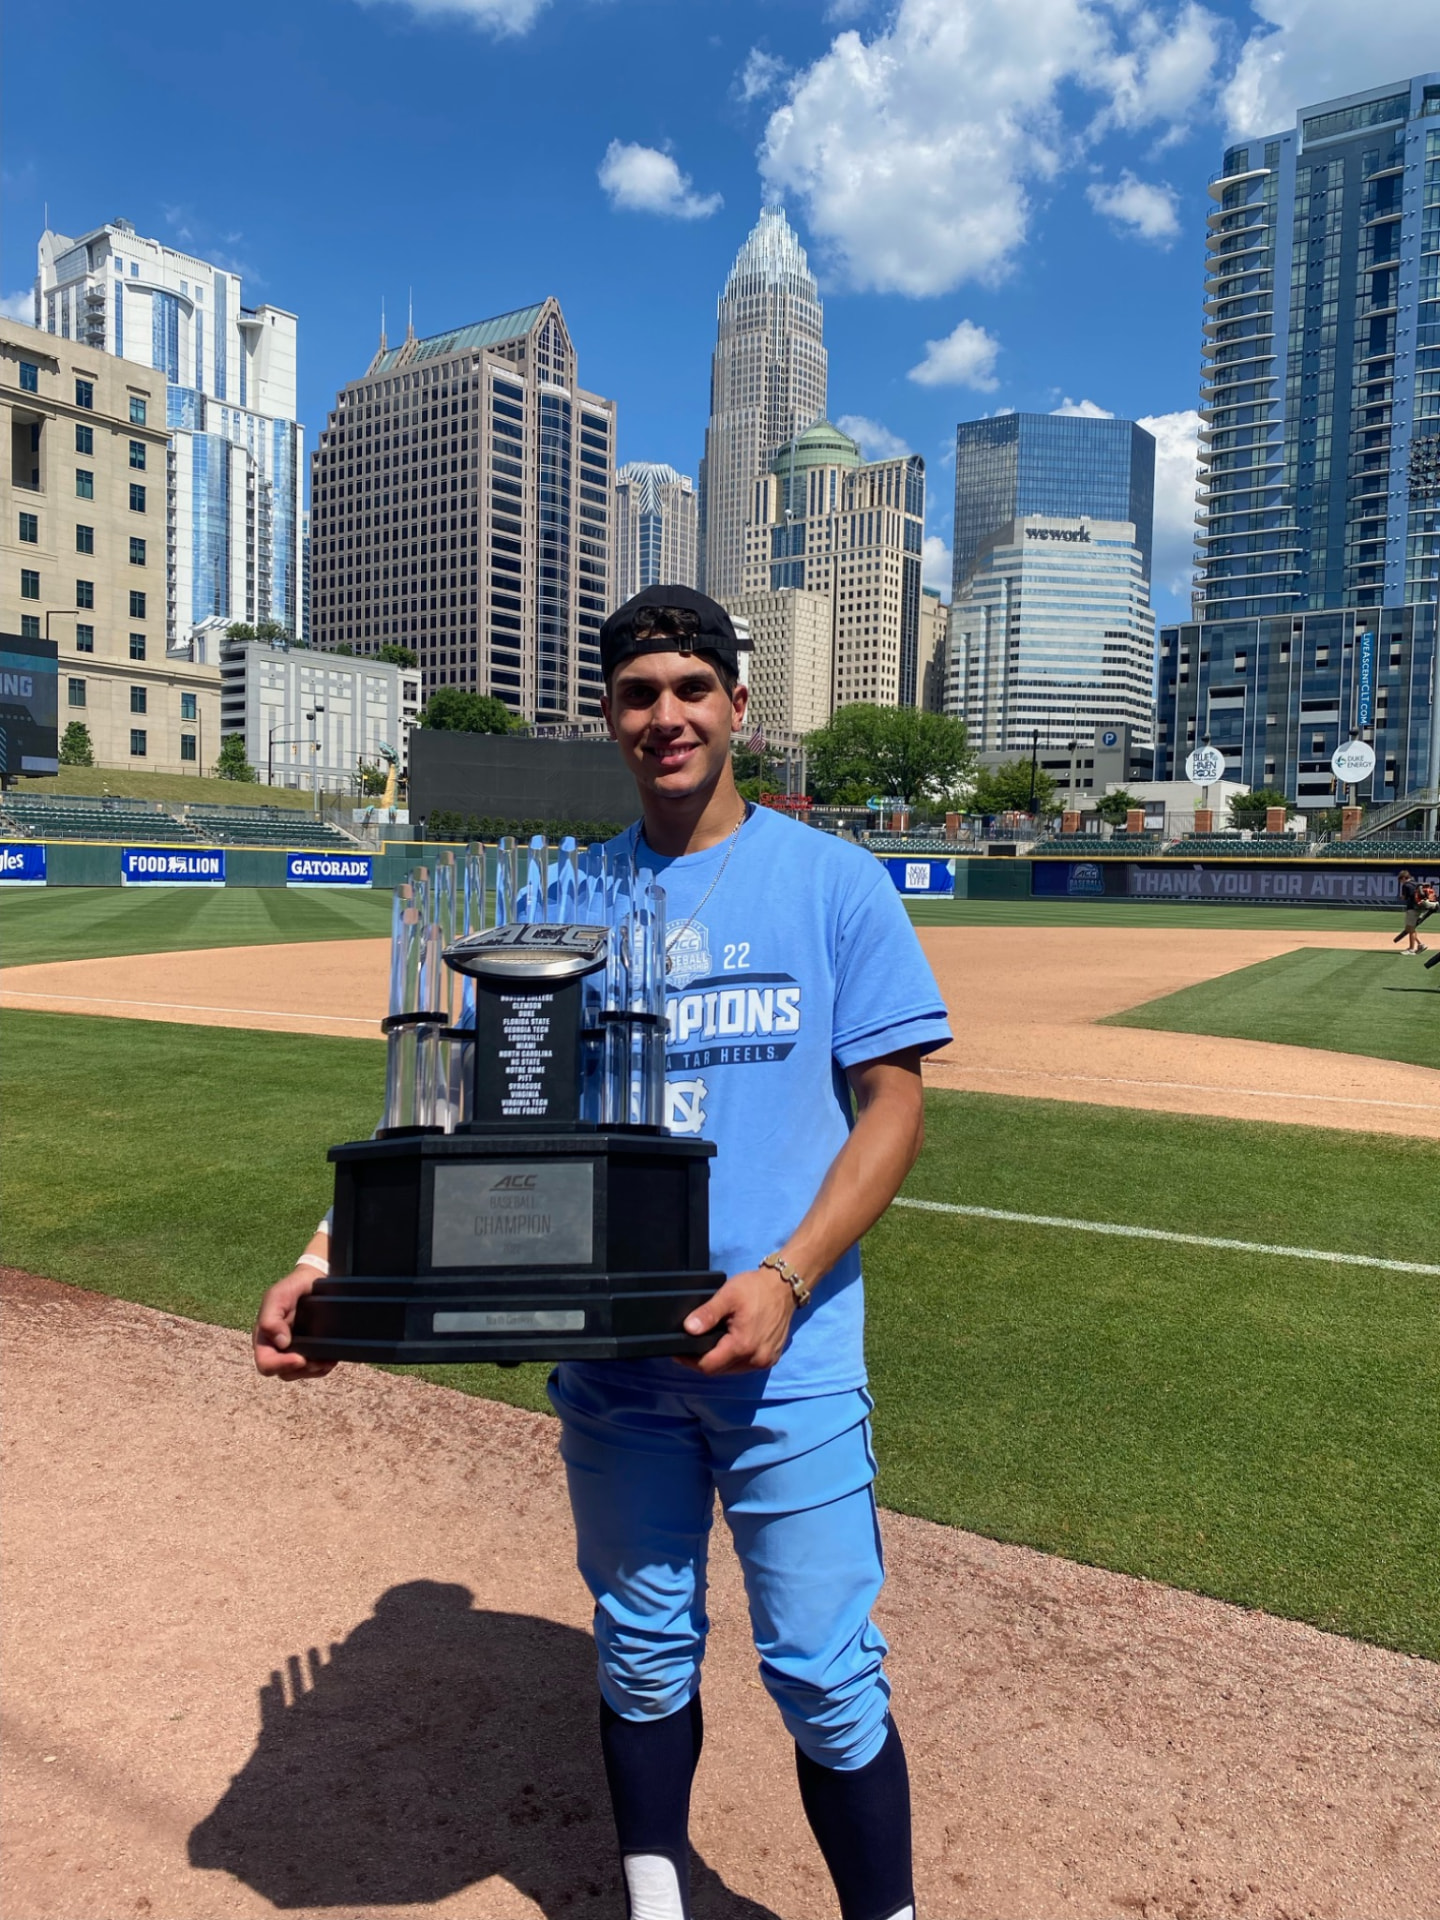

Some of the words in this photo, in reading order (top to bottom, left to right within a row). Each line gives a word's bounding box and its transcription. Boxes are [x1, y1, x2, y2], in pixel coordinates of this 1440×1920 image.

[1025, 525, 1091, 543] wework
[1360, 633, 1372, 724] LIVEASCENTCLT.COM
[1105, 733, 1115, 745] P
[1193, 753, 1211, 762] BLUE
[1193, 761, 1217, 769] HAVEN
[1193, 769, 1217, 777] POOLS
[129, 856, 167, 872] FOOD
[188, 858, 219, 874] LION
[291, 860, 369, 876] GATORADE
[909, 878, 926, 886] LIFE
[1133, 872, 1202, 893] THANK
[1211, 873, 1249, 893] YOU
[1261, 874, 1300, 894] FOR
[460, 923, 608, 946] ACC
[723, 942, 751, 970] 22
[512, 1002, 542, 1010] CLEMSON
[502, 1018, 530, 1026] FLORIDA
[530, 1017, 551, 1025] STATE
[532, 1025, 549, 1033] TECH
[508, 1034, 544, 1042] LOUISVILLE
[498, 1050, 520, 1058] NORTH
[521, 1050, 553, 1058] CAROLINA
[683, 1052, 711, 1068] TAR
[720, 1046, 775, 1063] HEELS
[521, 1058, 540, 1066] STATE
[505, 1066, 526, 1074] NOTRE
[527, 1066, 546, 1074] DAME
[517, 1074, 533, 1082] PITT
[508, 1082, 541, 1090] SYRACUSE
[510, 1090, 540, 1098] VIRGINIA
[501, 1098, 531, 1106] VIRGINIA
[531, 1098, 549, 1106] TECH
[502, 1107, 521, 1115] WAKE
[522, 1106, 547, 1115] FOREST
[494, 1174, 538, 1188] ACC
[489, 1195, 536, 1210] BASEBALL
[473, 1214, 551, 1237] CHAMPION
